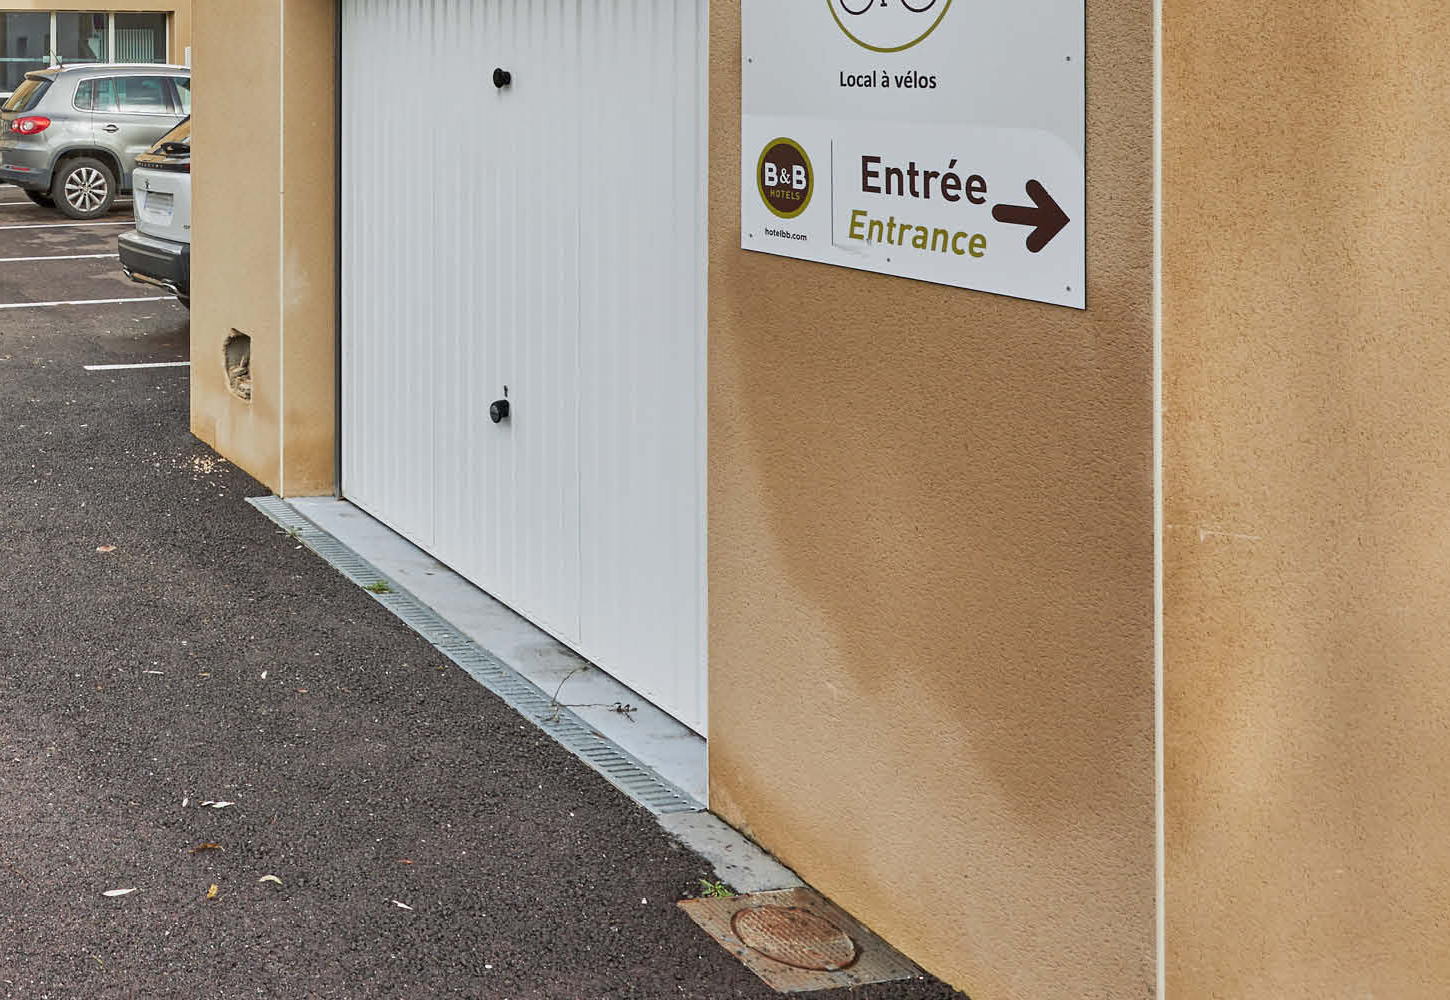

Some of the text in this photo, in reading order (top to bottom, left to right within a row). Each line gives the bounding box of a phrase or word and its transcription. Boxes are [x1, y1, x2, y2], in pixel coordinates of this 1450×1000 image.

[840, 71, 937, 89] Local à vélos
[764, 162, 807, 190] B&B
[861, 155, 988, 205] Entrée
[770, 189, 800, 201] HOTELS
[764, 228, 808, 241] hotelbb.com
[849, 209, 987, 258] Entrance
